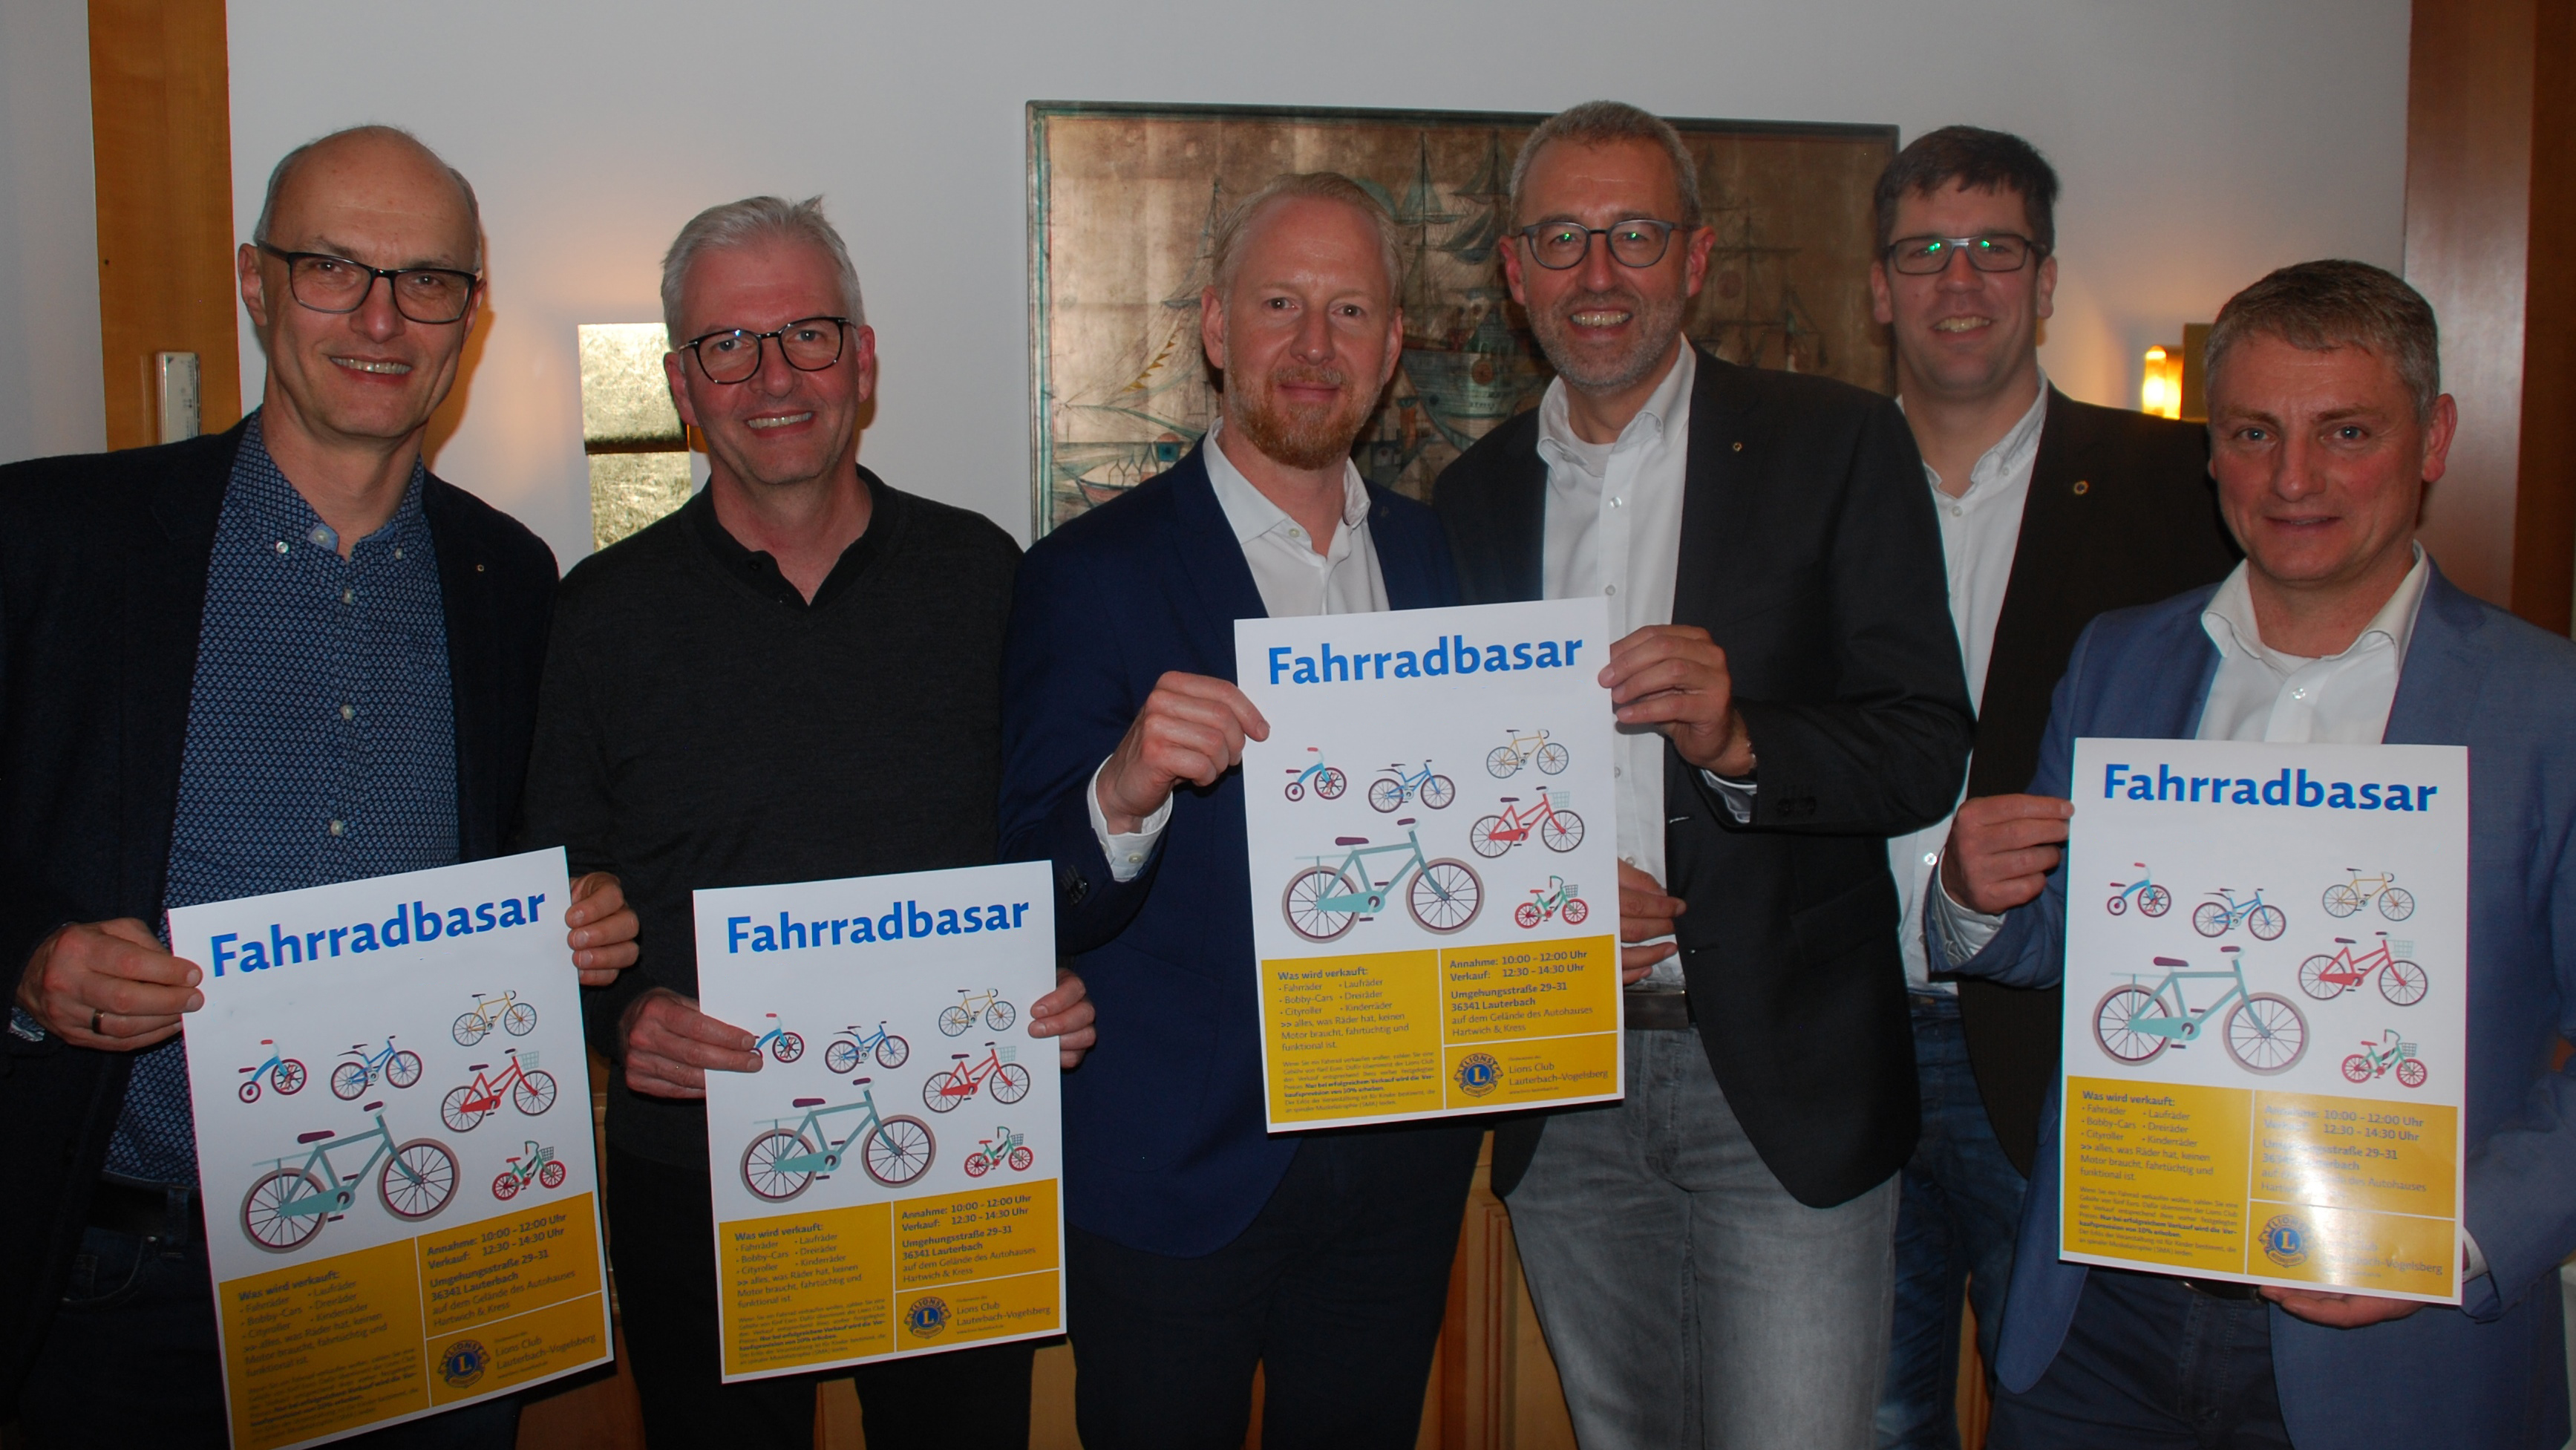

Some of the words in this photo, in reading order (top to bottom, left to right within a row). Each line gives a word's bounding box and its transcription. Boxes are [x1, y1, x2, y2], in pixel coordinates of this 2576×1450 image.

[1268, 635, 1583, 685] Fahrradbasar
[2103, 763, 2438, 811] Fahrradbasar
[728, 900, 1029, 953] Fahrradbasar
[210, 893, 545, 977] Fahrradbasar
[1448, 958, 1498, 968] Annahme:
[1501, 953, 1531, 964] 10:00
[1539, 950, 1567, 961] 12:00
[1569, 950, 1587, 959] Uhr
[1277, 971, 1299, 980] Was
[1301, 969, 1323, 979] wird
[1324, 966, 1368, 977] verkauft:
[1449, 970, 1491, 982] Verkauf:
[1502, 967, 1529, 977] 12:30
[1537, 964, 1565, 974] 14:30
[1566, 963, 1585, 973] Uhr
[1283, 982, 1323, 992] Fahrräder
[1344, 978, 1383, 989] Laufräder
[1450, 983, 1537, 999] Umgehungsstraße
[1539, 982, 1567, 992] 29-31
[1284, 993, 1333, 1005] Bobby-Cars
[1344, 990, 1383, 1000] Dreiräder
[1284, 1006, 1322, 1017] Cityroller
[1345, 1002, 1392, 1011] Kinderräder
[1451, 1001, 1480, 1012] 36341
[1482, 996, 1536, 1010] Lauterbach
[1294, 1018, 1314, 1028] alles,
[1335, 1016, 1359, 1024] Räder
[1360, 1014, 1376, 1022] hat,
[1378, 1013, 1405, 1021] keinen
[1451, 1014, 1465, 1025] auf
[1468, 1014, 1488, 1023] dem
[1489, 1011, 1525, 1022] Gelände
[1526, 1010, 1541, 1019] des
[1543, 1007, 1592, 1016] Autohauses
[1281, 1031, 1307, 1039] Motor
[1310, 1028, 1344, 1038] braucht,
[1345, 1025, 1391, 1035] fahrtüchtig
[1393, 1022, 1409, 1032] und
[1452, 1025, 1491, 1036] Hartwich
[1493, 1025, 1502, 1033] &
[1503, 1024, 1526, 1032] Kress
[1281, 1041, 1324, 1051] funktional
[1325, 1040, 1337, 1048] ist.
[1462, 1051, 1494, 1066] LIONS
[1472, 1065, 1486, 1084] L
[1508, 1065, 1532, 1074] Lions
[1534, 1062, 1555, 1071] Club
[1508, 1069, 1608, 1085] Lauterbach-Vogelsberg
[2082, 1090, 2104, 1100] Was
[2105, 1093, 2128, 1103] wird
[2086, 1103, 2126, 1115] Fahrräder
[2148, 1108, 2190, 1120] Laufräder
[2086, 1116, 2137, 1129] Bobby-Cars
[2323, 1109, 2357, 1121] 10:00
[2367, 1112, 2400, 1125] 12:00
[2402, 1116, 2424, 1127] Uhr
[2085, 1129, 2124, 1140] Cityroller
[2147, 1121, 2188, 1133] Dreiräder
[2323, 1123, 2355, 1135] 12:30
[2364, 1127, 2396, 1139] 14:30
[2398, 1130, 2419, 1141] Uhr
[2147, 1134, 2197, 1147] Kinderräder
[2135, 1146, 2160, 1157] Räder
[2181, 1151, 2210, 1161] keinen
[2079, 1154, 2106, 1164] Motor
[2145, 1160, 2194, 1176] fahrtüchtig
[2196, 1166, 2214, 1175] und
[2079, 1166, 2122, 1179] funktional
[2367, 1177, 2427, 1192] Autohauses
[900, 1207, 947, 1219] Annahme:
[950, 1201, 978, 1213] 10:00
[986, 1196, 1013, 1207] 12:00
[1014, 1195, 1031, 1204] Uhr
[901, 1218, 941, 1232] Verkauf:
[951, 1213, 977, 1225] 12:30
[984, 1209, 1010, 1220] 14:30
[1011, 1206, 1029, 1216] Uhr
[481, 1227, 510, 1243] 10:00
[518, 1217, 547, 1232] 12:00
[548, 1213, 566, 1224] Uhr
[734, 1232, 756, 1241] Was
[758, 1227, 779, 1238] wird
[781, 1222, 823, 1235] verkauft:
[901, 1229, 984, 1248] Umgehungsstraße
[985, 1224, 1013, 1236] 29-31
[482, 1241, 509, 1256] 12:30
[517, 1231, 546, 1247] 14:30
[546, 1227, 565, 1238] Uhr
[740, 1240, 779, 1252] Fahrräder
[799, 1232, 837, 1244] Laufräder
[2280, 1229, 2295, 1251] L
[741, 1250, 789, 1264] Bobby-Cars
[799, 1244, 837, 1255] Dreiräder
[902, 1249, 929, 1261] 36341
[932, 1241, 983, 1256] Lauterbach
[800, 1254, 846, 1266] Kinderräder
[902, 1261, 916, 1272] auf
[918, 1261, 937, 1270] dem
[938, 1255, 972, 1267] Gelände
[974, 1254, 988, 1262] des
[989, 1247, 1036, 1259] Autohauses
[430, 1258, 519, 1288] Umgehungsstraße
[741, 1263, 778, 1275] Cityroller
[750, 1276, 770, 1284] alles,
[790, 1270, 813, 1278] Räder
[815, 1267, 830, 1276] hat,
[831, 1264, 858, 1273] keinen
[903, 1271, 939, 1283] Hartwich
[238, 1290, 262, 1301] Was
[265, 1281, 289, 1295] wird
[431, 1286, 461, 1302] 36341
[463, 1271, 518, 1293] Lauterbach
[432, 1302, 447, 1316] auf
[449, 1299, 470, 1310] dem
[472, 1288, 508, 1304] Gelände
[509, 1284, 525, 1294] des
[526, 1270, 576, 1290] Autohauses
[736, 1288, 762, 1297] Motor
[765, 1282, 798, 1293] braucht,
[800, 1277, 845, 1289] fahrtüchtig
[846, 1273, 862, 1283] und
[737, 1296, 778, 1308] funktional
[780, 1294, 791, 1302] ist.
[912, 1295, 942, 1310] LIONS
[956, 1306, 978, 1315] Lions
[980, 1301, 1000, 1311] Club
[921, 1307, 935, 1326] L
[956, 1306, 1050, 1326] Lauterbach-Vogelsberg
[446, 1336, 479, 1356] LIONS
[495, 1344, 520, 1357] Lions
[521, 1335, 542, 1349] Club
[496, 1333, 598, 1370] Lauterbach-Vogelsberg
[457, 1352, 472, 1374] L
